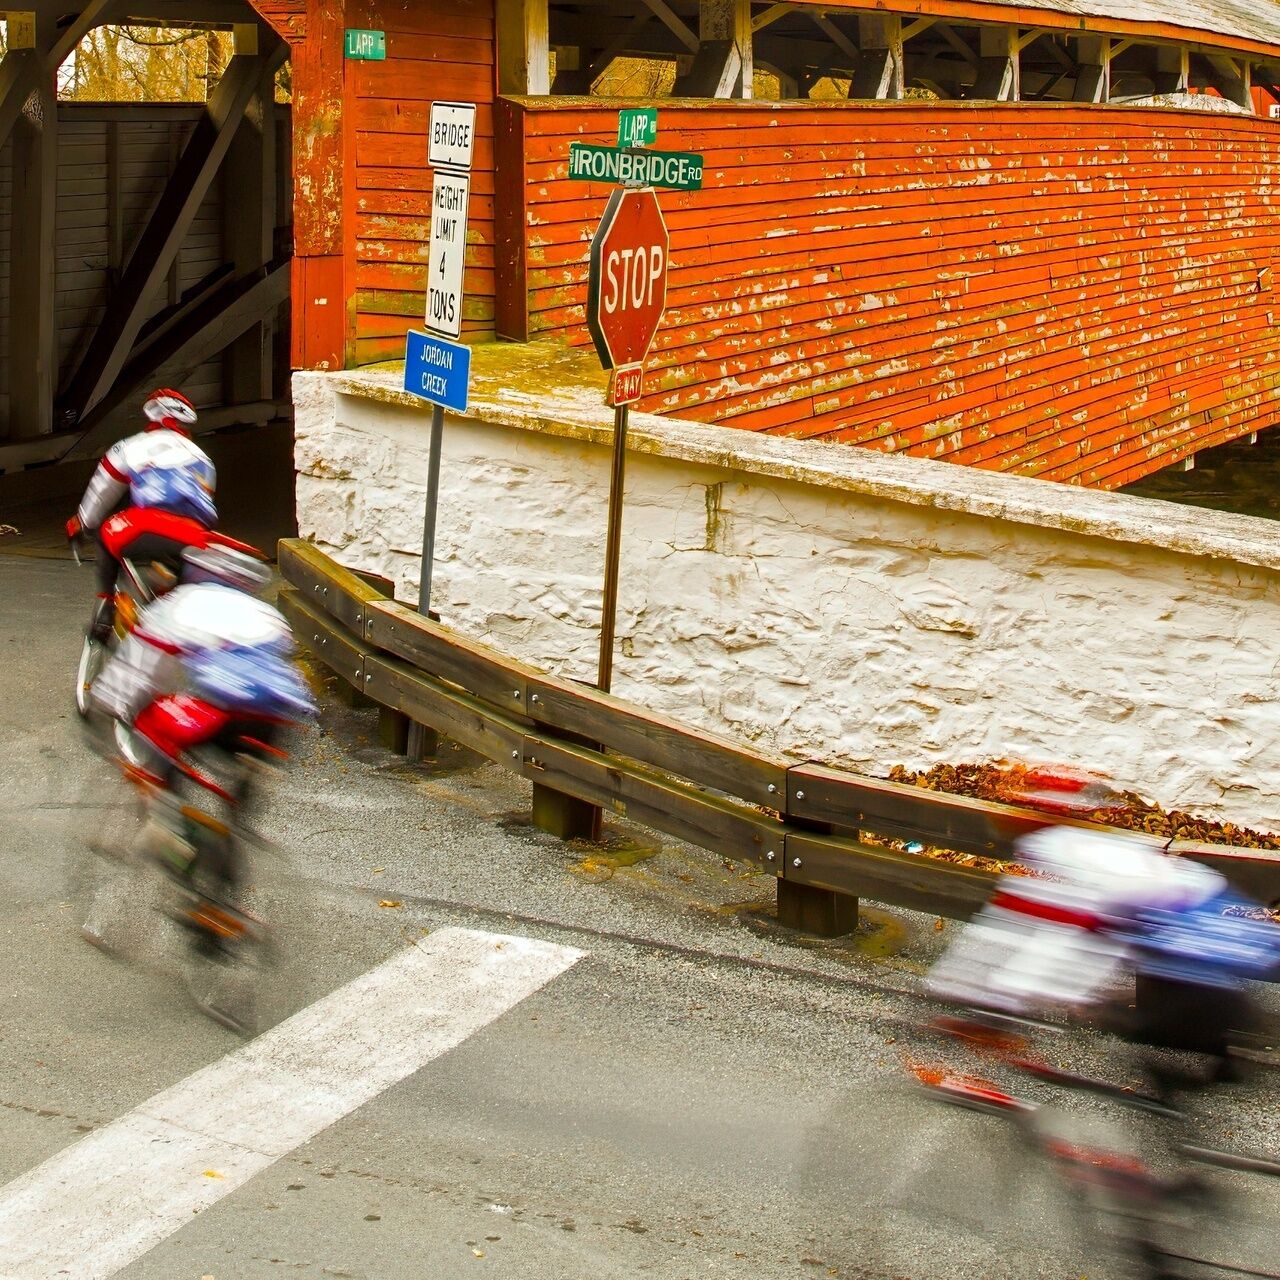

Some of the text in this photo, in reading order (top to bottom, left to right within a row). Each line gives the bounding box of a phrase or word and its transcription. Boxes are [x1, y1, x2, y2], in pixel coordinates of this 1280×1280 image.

[349, 32, 374, 56] LAPP
[434, 122, 470, 148] BRIDGE
[623, 114, 648, 141] LAPP
[573, 149, 690, 185] IRONBRIDGE
[687, 166, 703, 181] RD
[435, 185, 466, 213] WEIGHT
[435, 219, 457, 243] LIMIT
[438, 251, 447, 281] 4
[604, 245, 663, 314] STOP
[428, 288, 456, 323] TONS
[420, 343, 453, 371] JORDAN
[421, 371, 448, 398] CREEK
